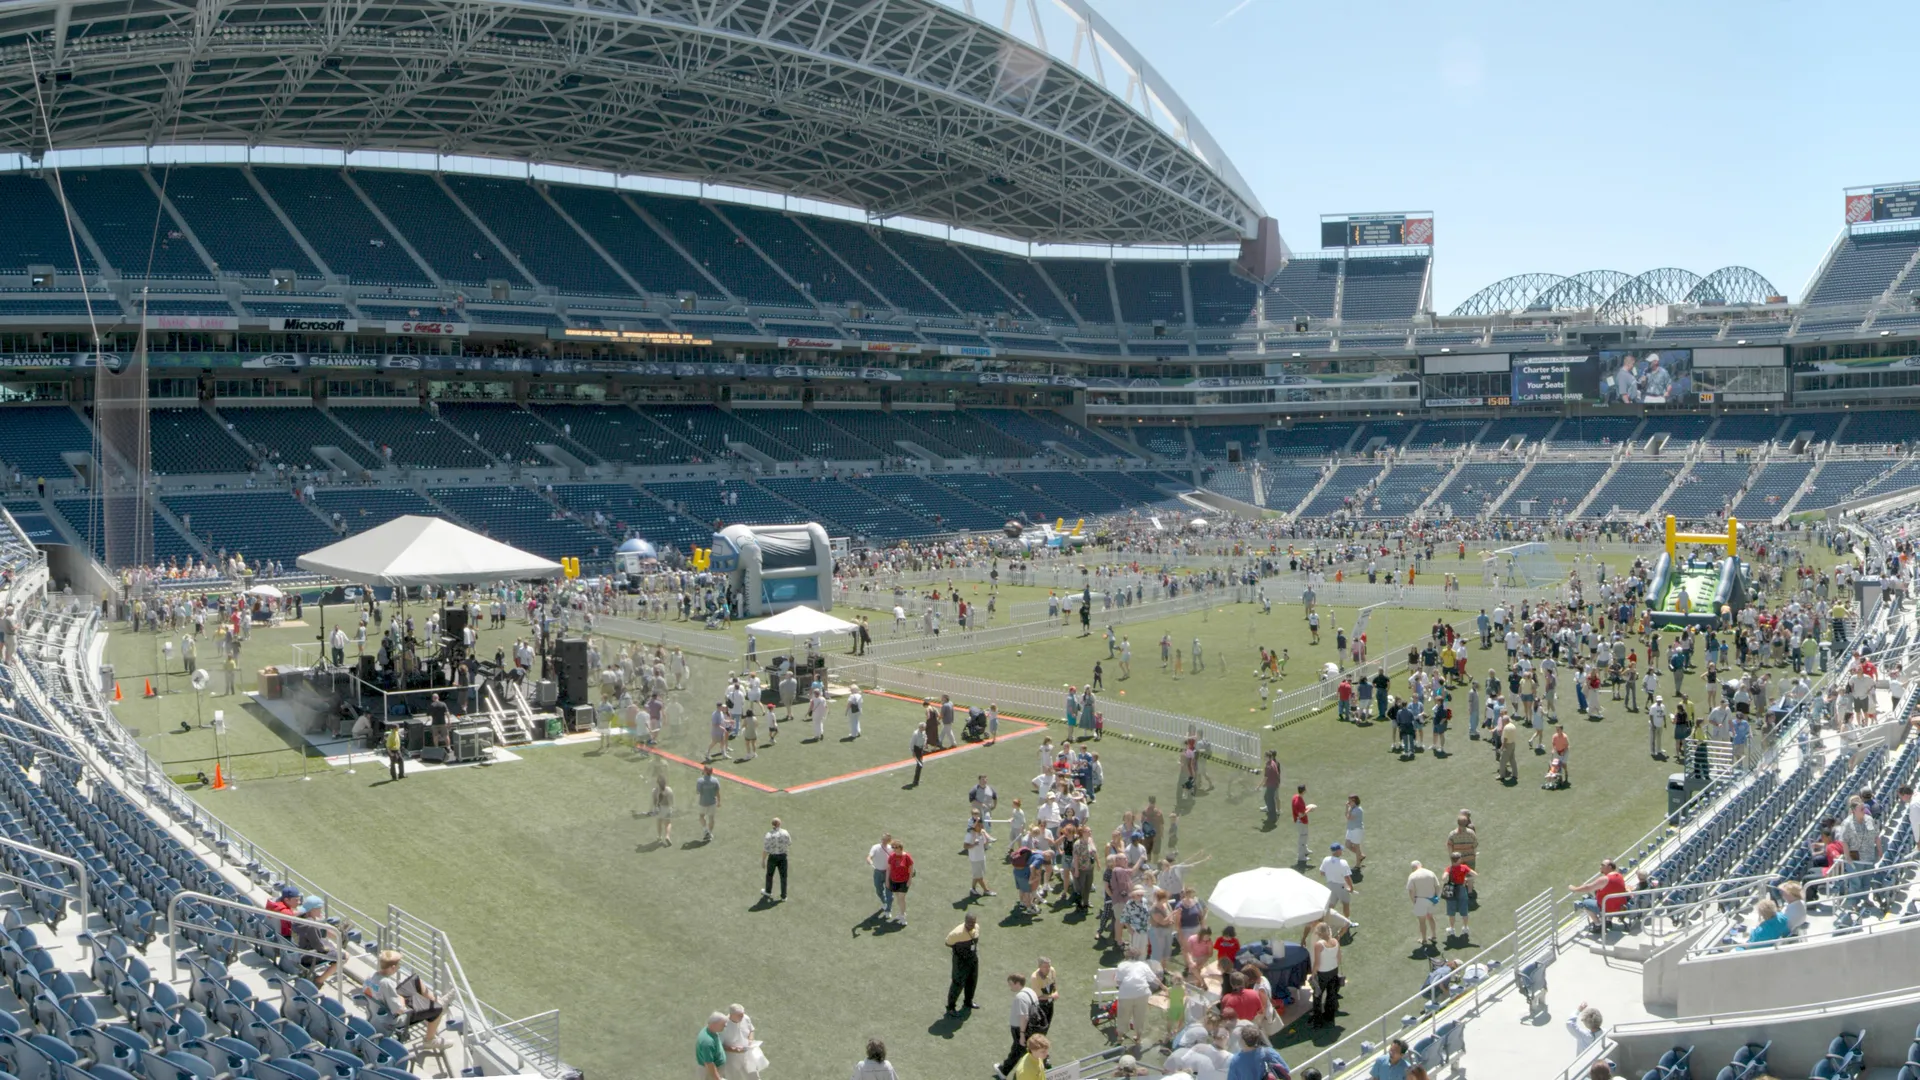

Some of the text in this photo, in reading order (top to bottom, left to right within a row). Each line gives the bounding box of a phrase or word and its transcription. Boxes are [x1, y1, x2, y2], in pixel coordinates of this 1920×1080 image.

[1846, 195, 1872, 222] HOME
[1406, 218, 1432, 243] HOME
[284, 319, 345, 330] Microsoft
[787, 338, 834, 347] Budweiser
[961, 347, 991, 356] PHILIPS
[309, 356, 378, 366] SEAHAWKS
[807, 368, 857, 377] SEAHAWKS
[1523, 366, 1549, 374] Charter
[1007, 375, 1049, 384] SEAHAWKS
[1487, 397, 1510, 406] 15:00
